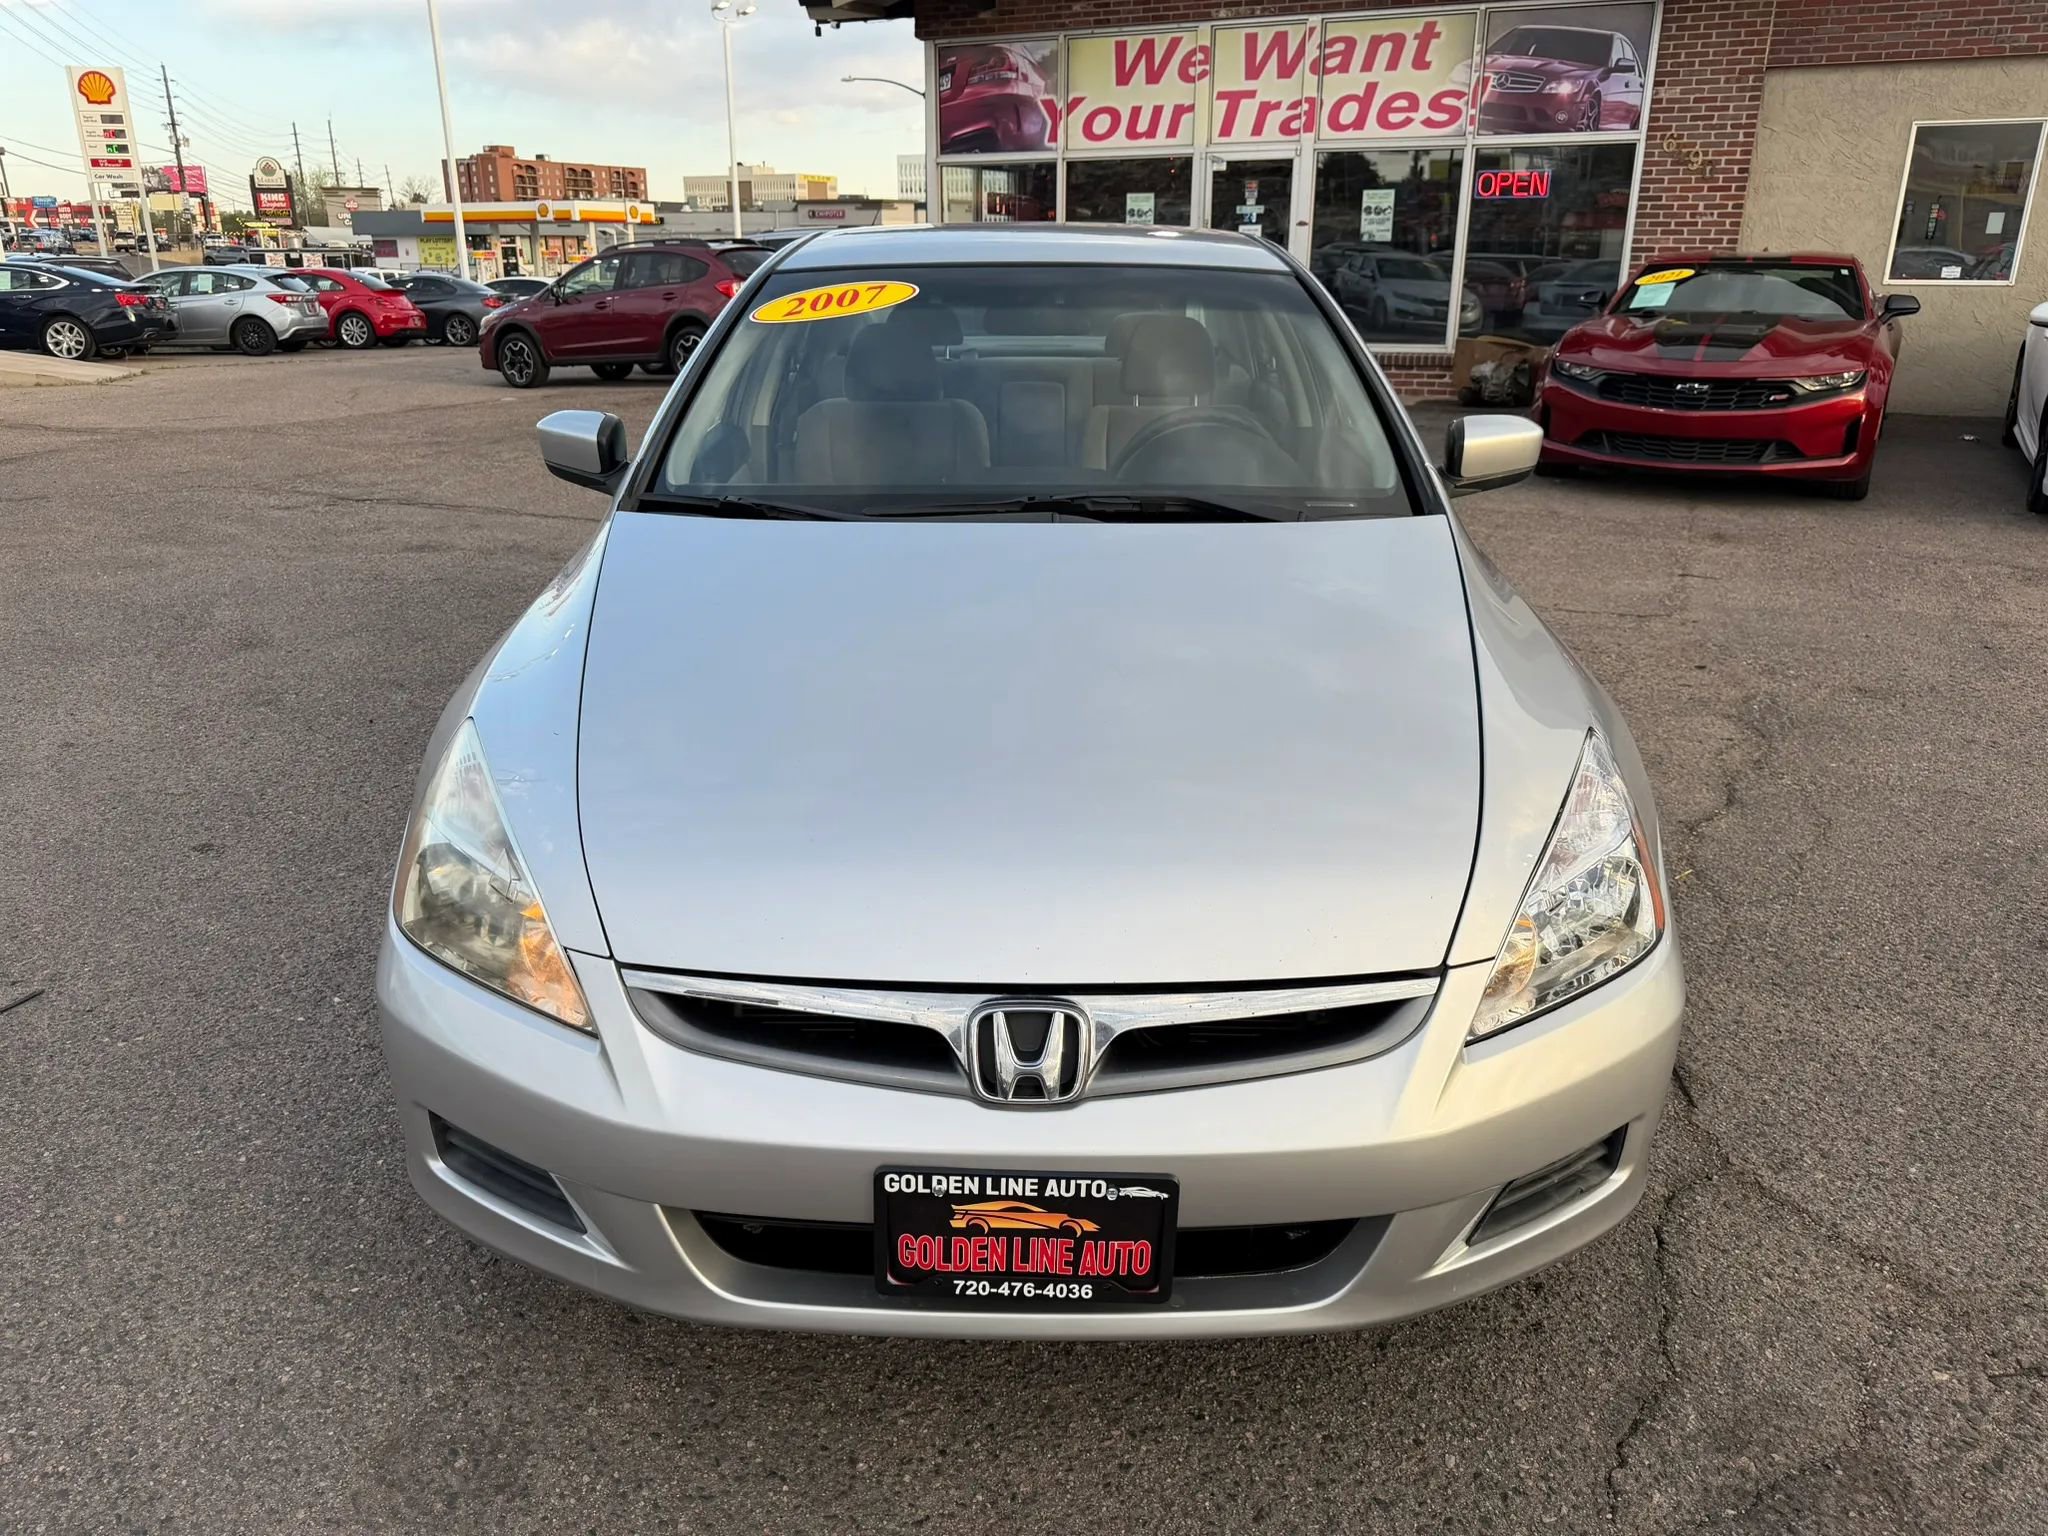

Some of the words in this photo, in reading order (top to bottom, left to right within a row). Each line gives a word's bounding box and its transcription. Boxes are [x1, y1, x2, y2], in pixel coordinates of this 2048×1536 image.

[1115, 36, 1210, 87] We
[1243, 20, 1442, 81] Want
[1039, 95, 1195, 144] Your
[1212, 76, 1490, 139] Trades!
[260, 193, 285, 201] KING
[1478, 171, 1549, 196] OPEN
[783, 284, 887, 317] 2007
[884, 1173, 980, 1197] GOLDEN
[986, 1177, 1039, 1197] LINE
[1045, 1178, 1107, 1198] AUTO
[898, 1233, 1007, 1272] GOLDEN
[1013, 1236, 1073, 1275] LINE
[1079, 1239, 1152, 1276] AUTO
[953, 1279, 1093, 1299] 720-476-4036
